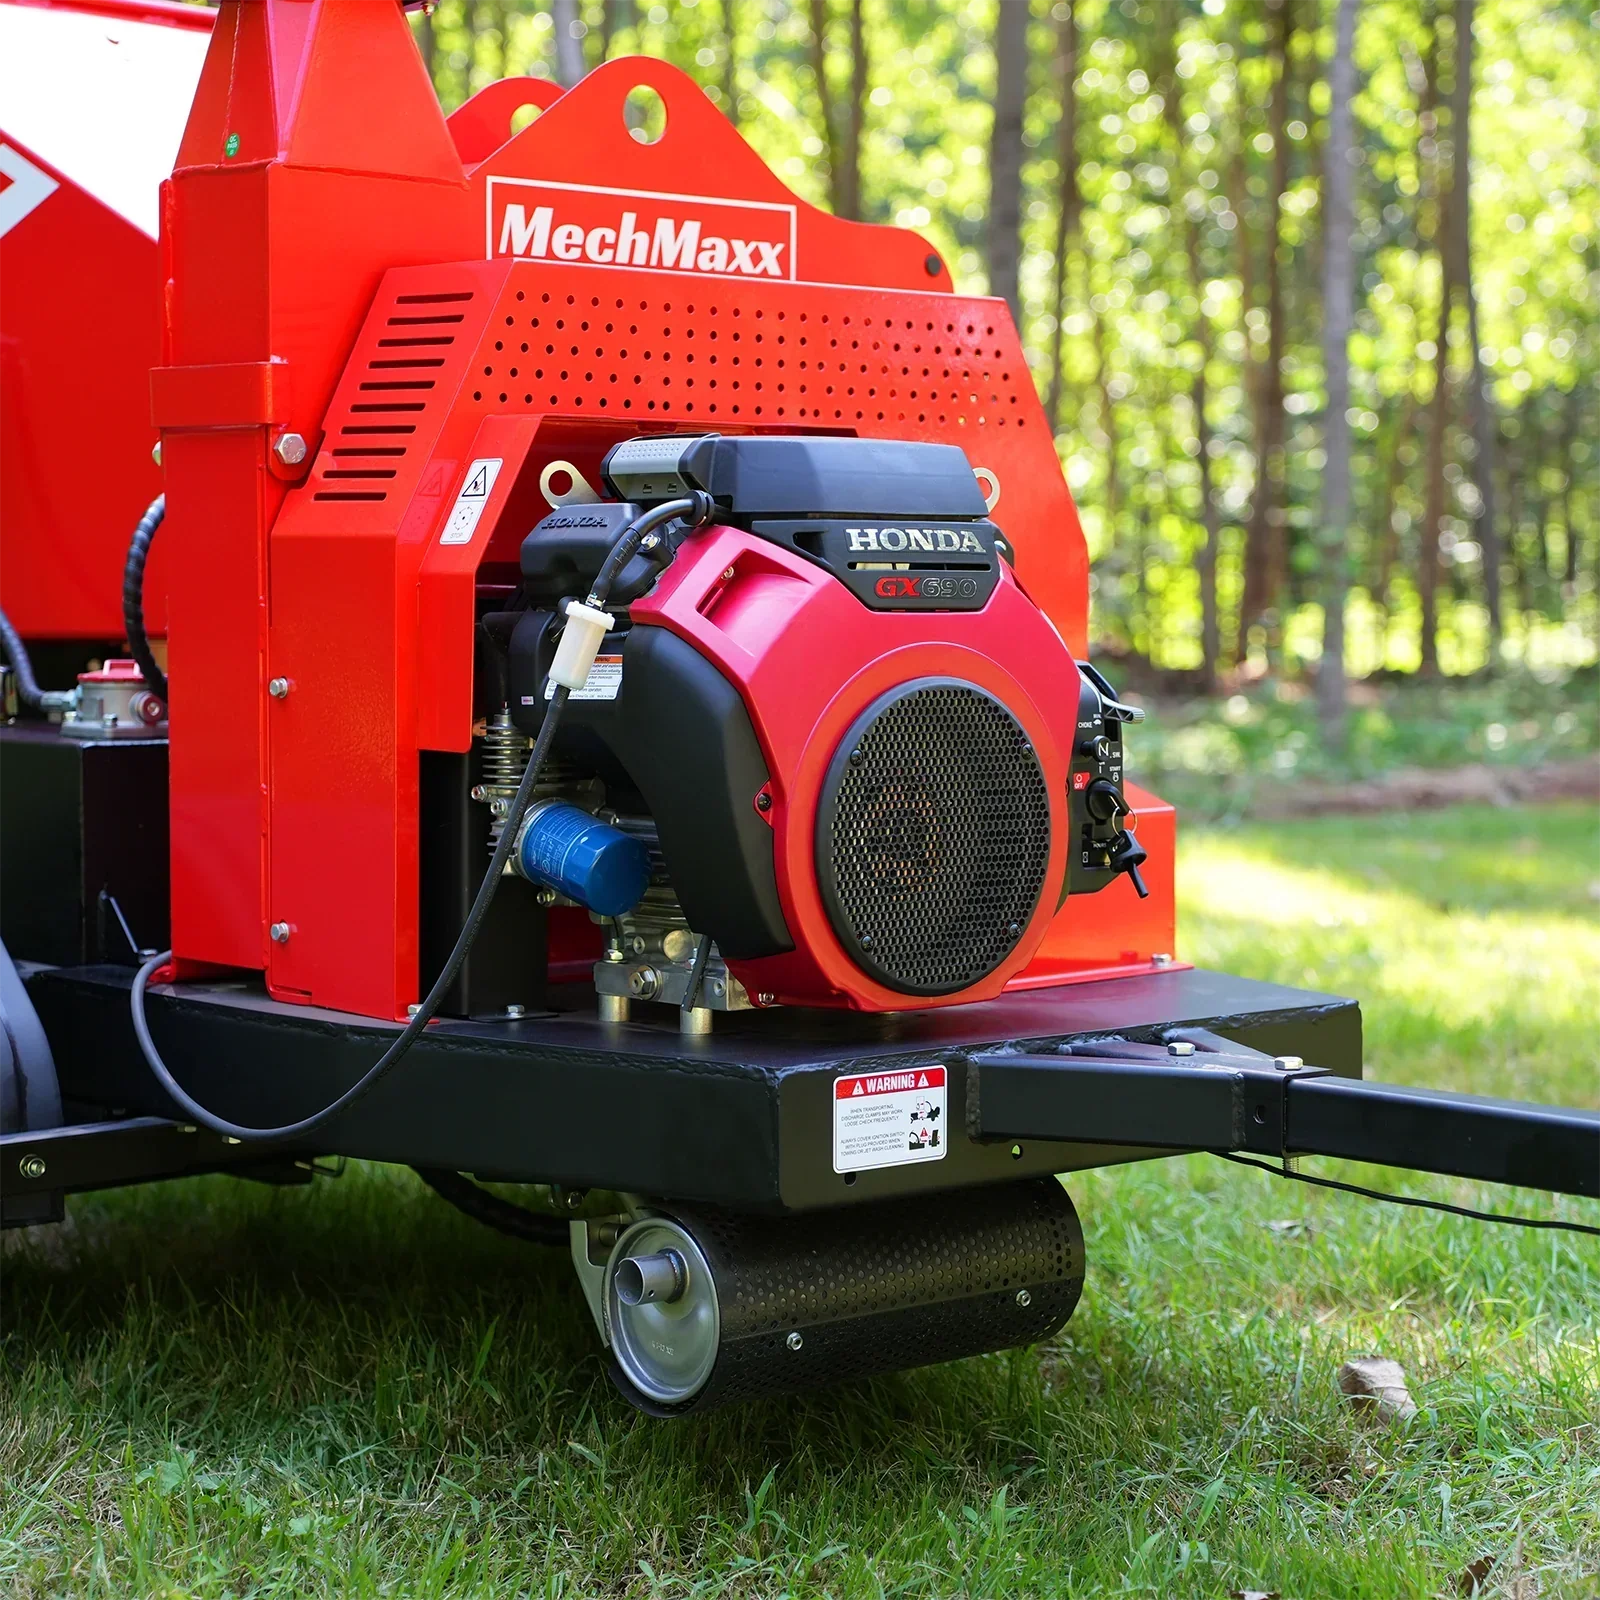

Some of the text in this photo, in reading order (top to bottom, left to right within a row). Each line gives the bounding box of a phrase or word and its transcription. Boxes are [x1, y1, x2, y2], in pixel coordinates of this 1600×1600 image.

[499, 203, 785, 276] MechMaxx
[541, 516, 608, 529] HONDA
[845, 528, 986, 553] HONDA
[866, 1073, 915, 1093] WARNING
